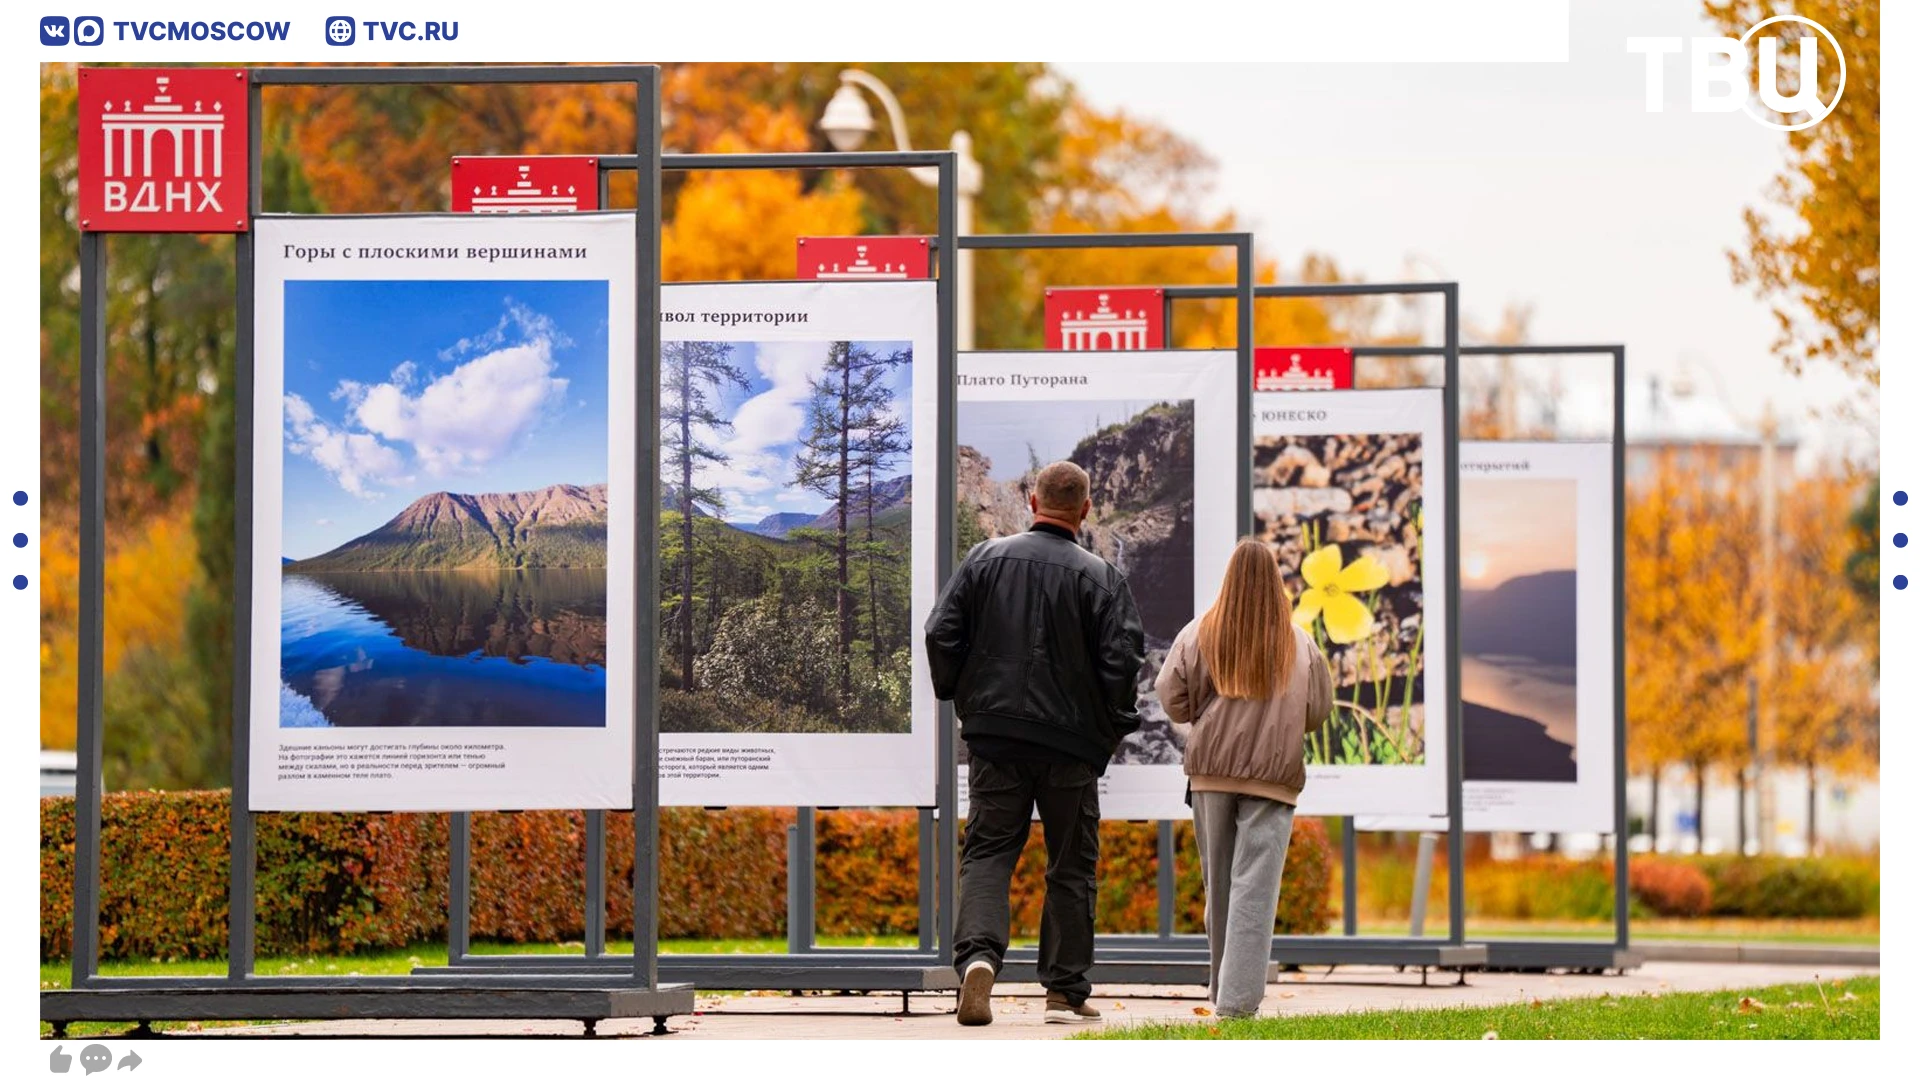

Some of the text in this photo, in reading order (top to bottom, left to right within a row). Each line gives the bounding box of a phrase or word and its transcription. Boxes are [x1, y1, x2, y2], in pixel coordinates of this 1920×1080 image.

[104, 181, 223, 213] ВДНХ
[283, 244, 587, 262] Горы с плоскими вершинами
[700, 312, 808, 326] территории
[957, 373, 1088, 388] Плато Путорана
[1262, 410, 1327, 421] ЮНЕСКО
[279, 744, 312, 752] Здешние
[408, 743, 439, 751] глубины
[290, 753, 335, 762] фотографии
